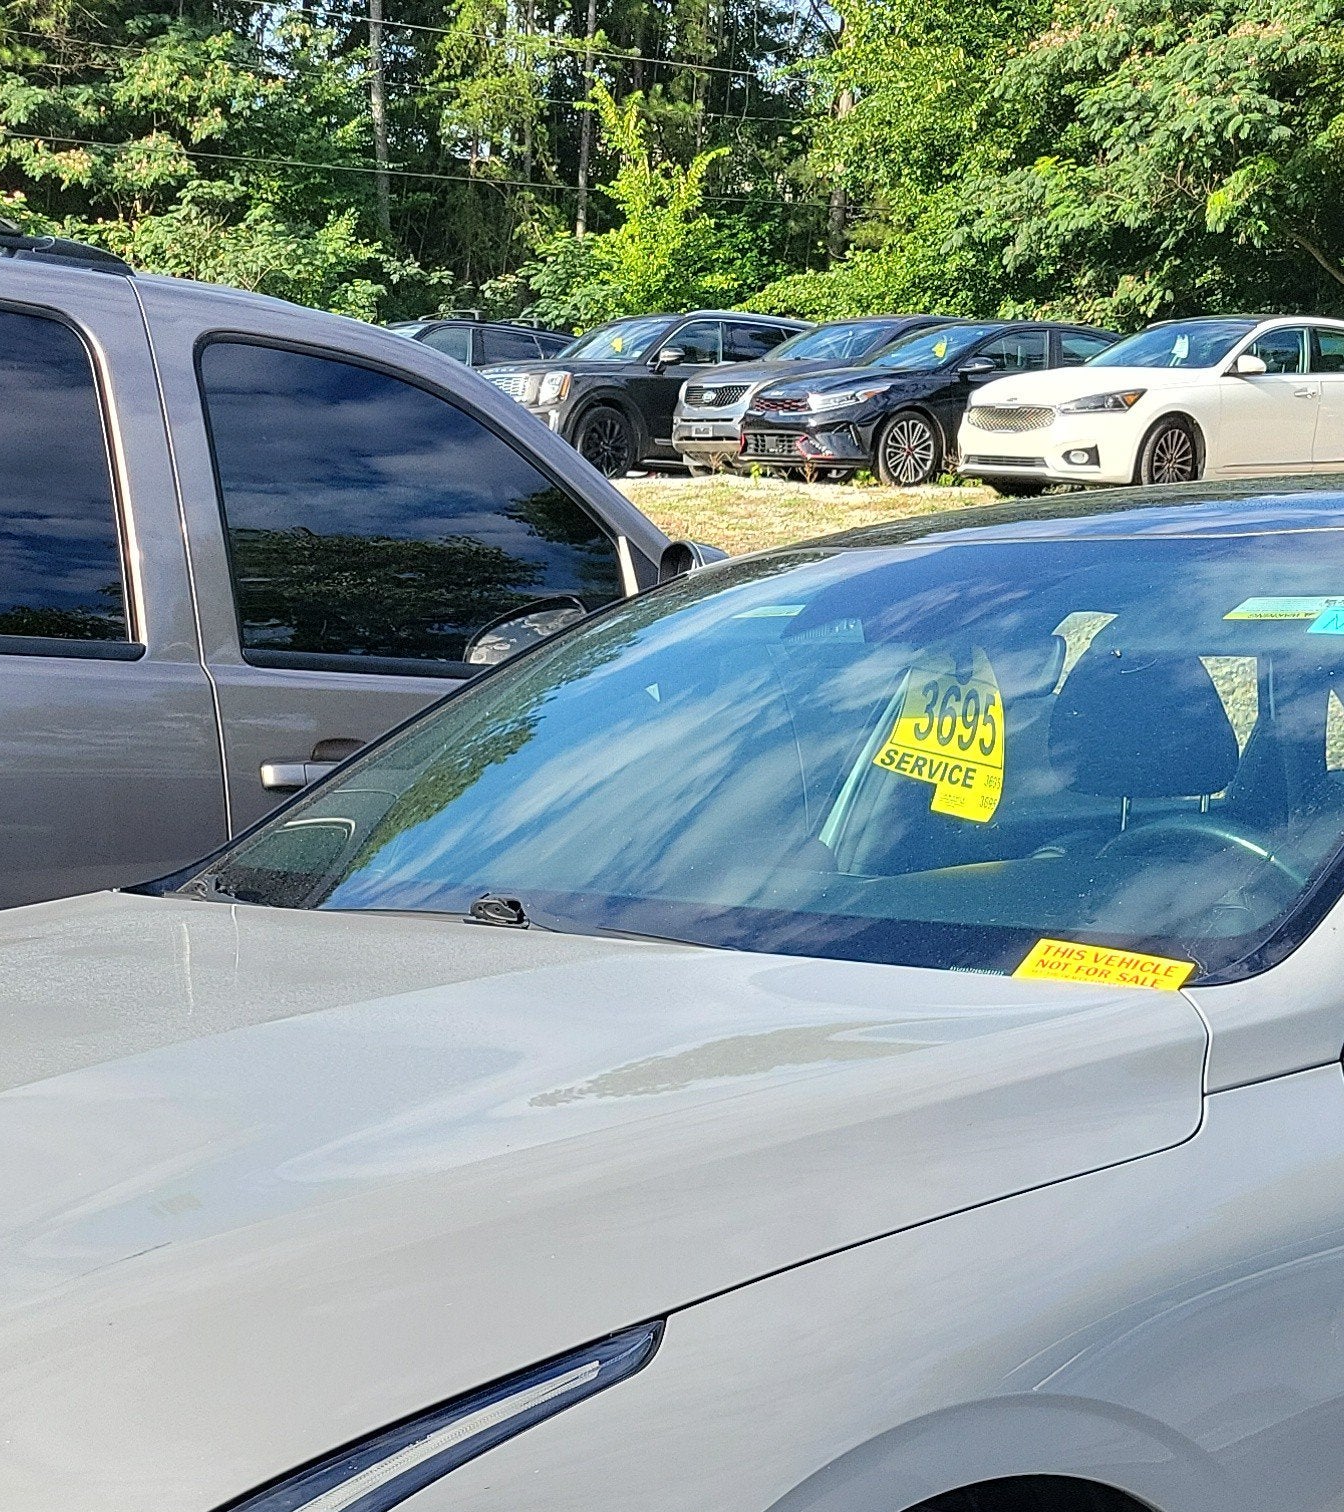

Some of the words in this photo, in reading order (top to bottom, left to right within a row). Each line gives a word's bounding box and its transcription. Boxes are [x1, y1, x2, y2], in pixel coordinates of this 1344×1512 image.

[914, 679, 997, 756] 3695
[880, 748, 977, 789] SERVICE
[1035, 958, 1072, 973] NOT
[1075, 964, 1112, 979] FOR
[1115, 972, 1166, 989] SALE
[1042, 944, 1088, 962] THIS
[1093, 951, 1180, 978] VEHICLE
